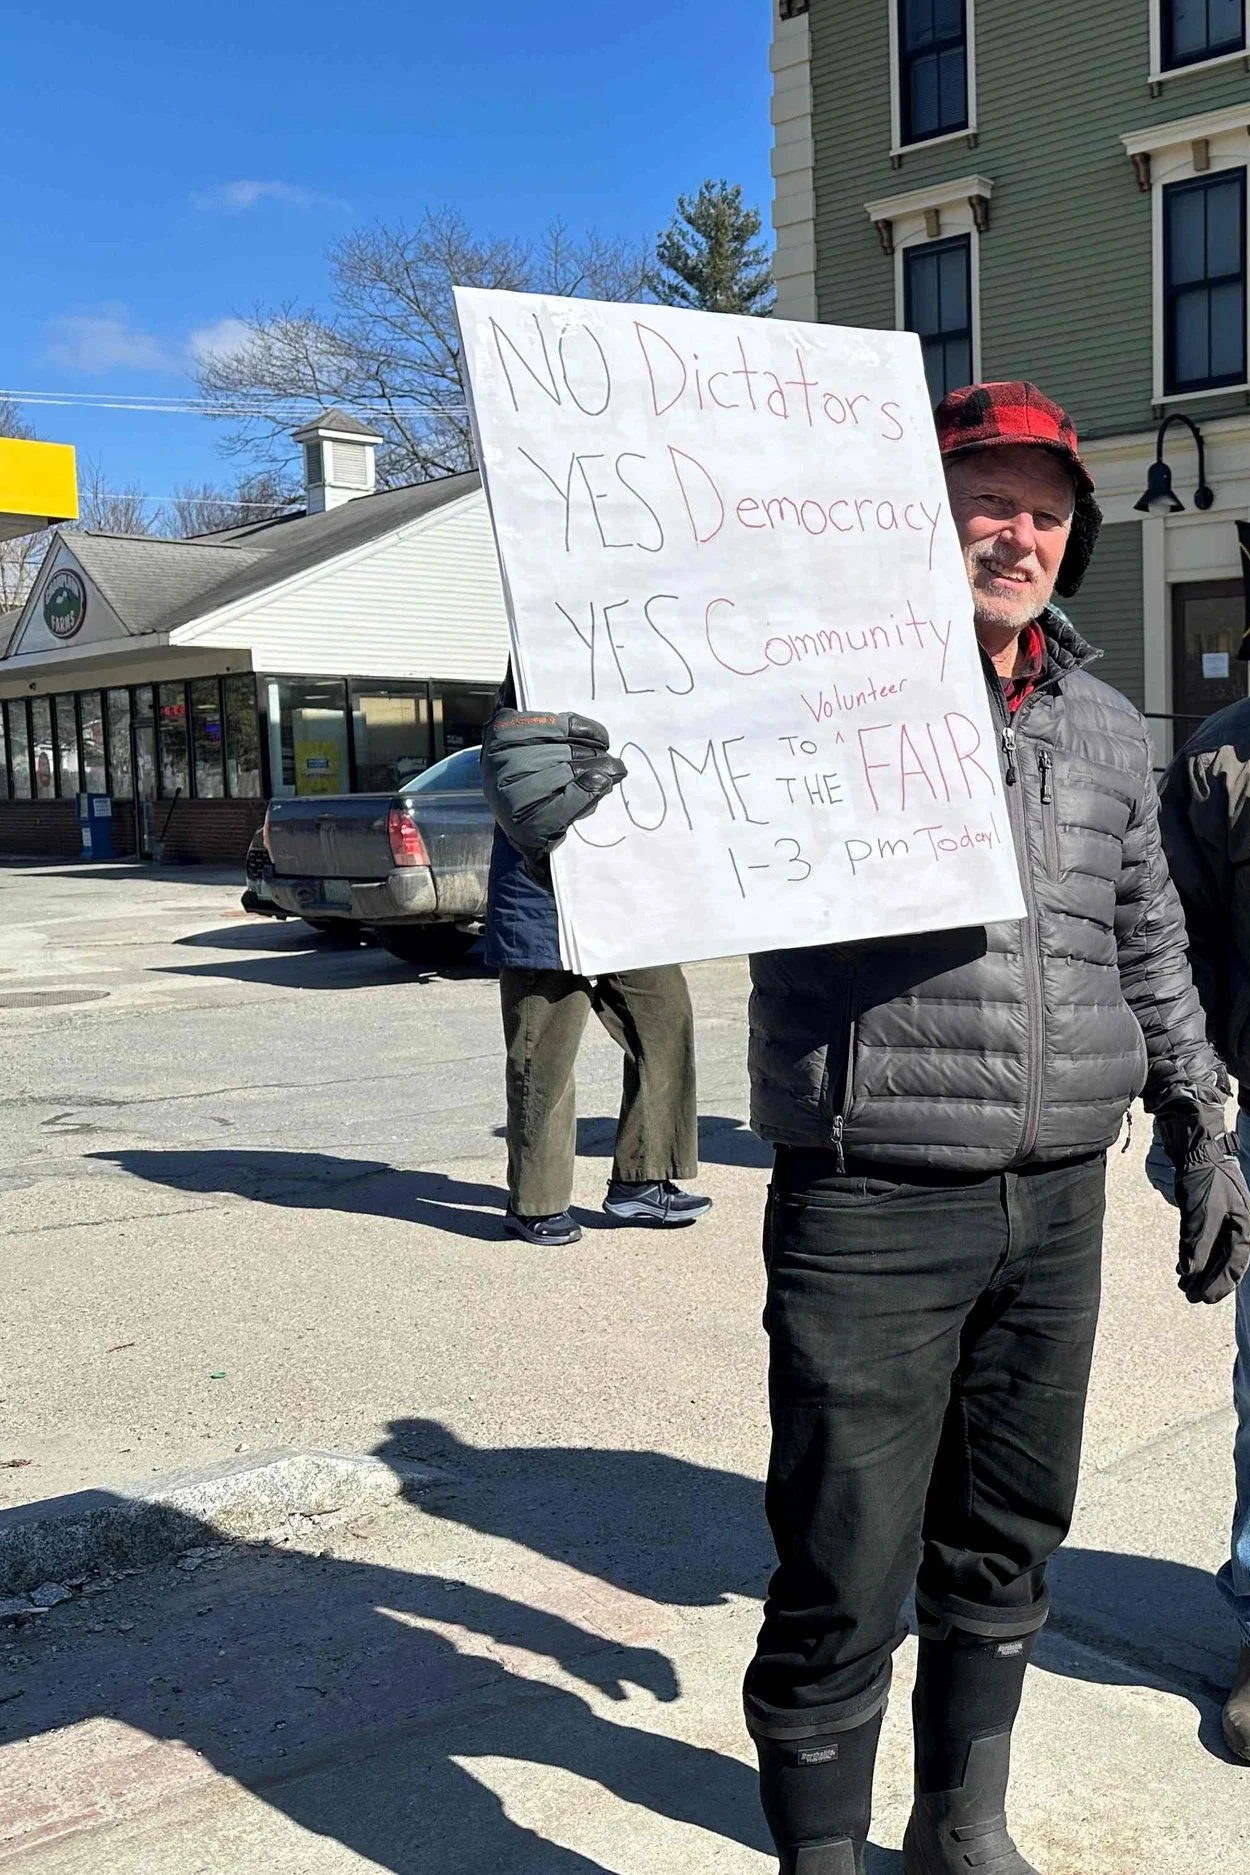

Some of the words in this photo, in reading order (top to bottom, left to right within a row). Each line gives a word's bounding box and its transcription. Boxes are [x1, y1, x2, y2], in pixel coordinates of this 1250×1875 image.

[488, 313, 611, 416] NO
[633, 321, 903, 440] Dictators
[518, 446, 664, 552] YES
[667, 445, 942, 570] Democracy
[51, 610, 75, 632] FARMS
[555, 594, 694, 700] YES
[705, 599, 951, 681] Community
[801, 677, 908, 723] Volunteer
[776, 773, 844, 805] THE
[778, 736, 818, 756] TO
[857, 712, 996, 811] FAIR
[728, 838, 811, 899] 1-3
[844, 838, 909, 876] pm
